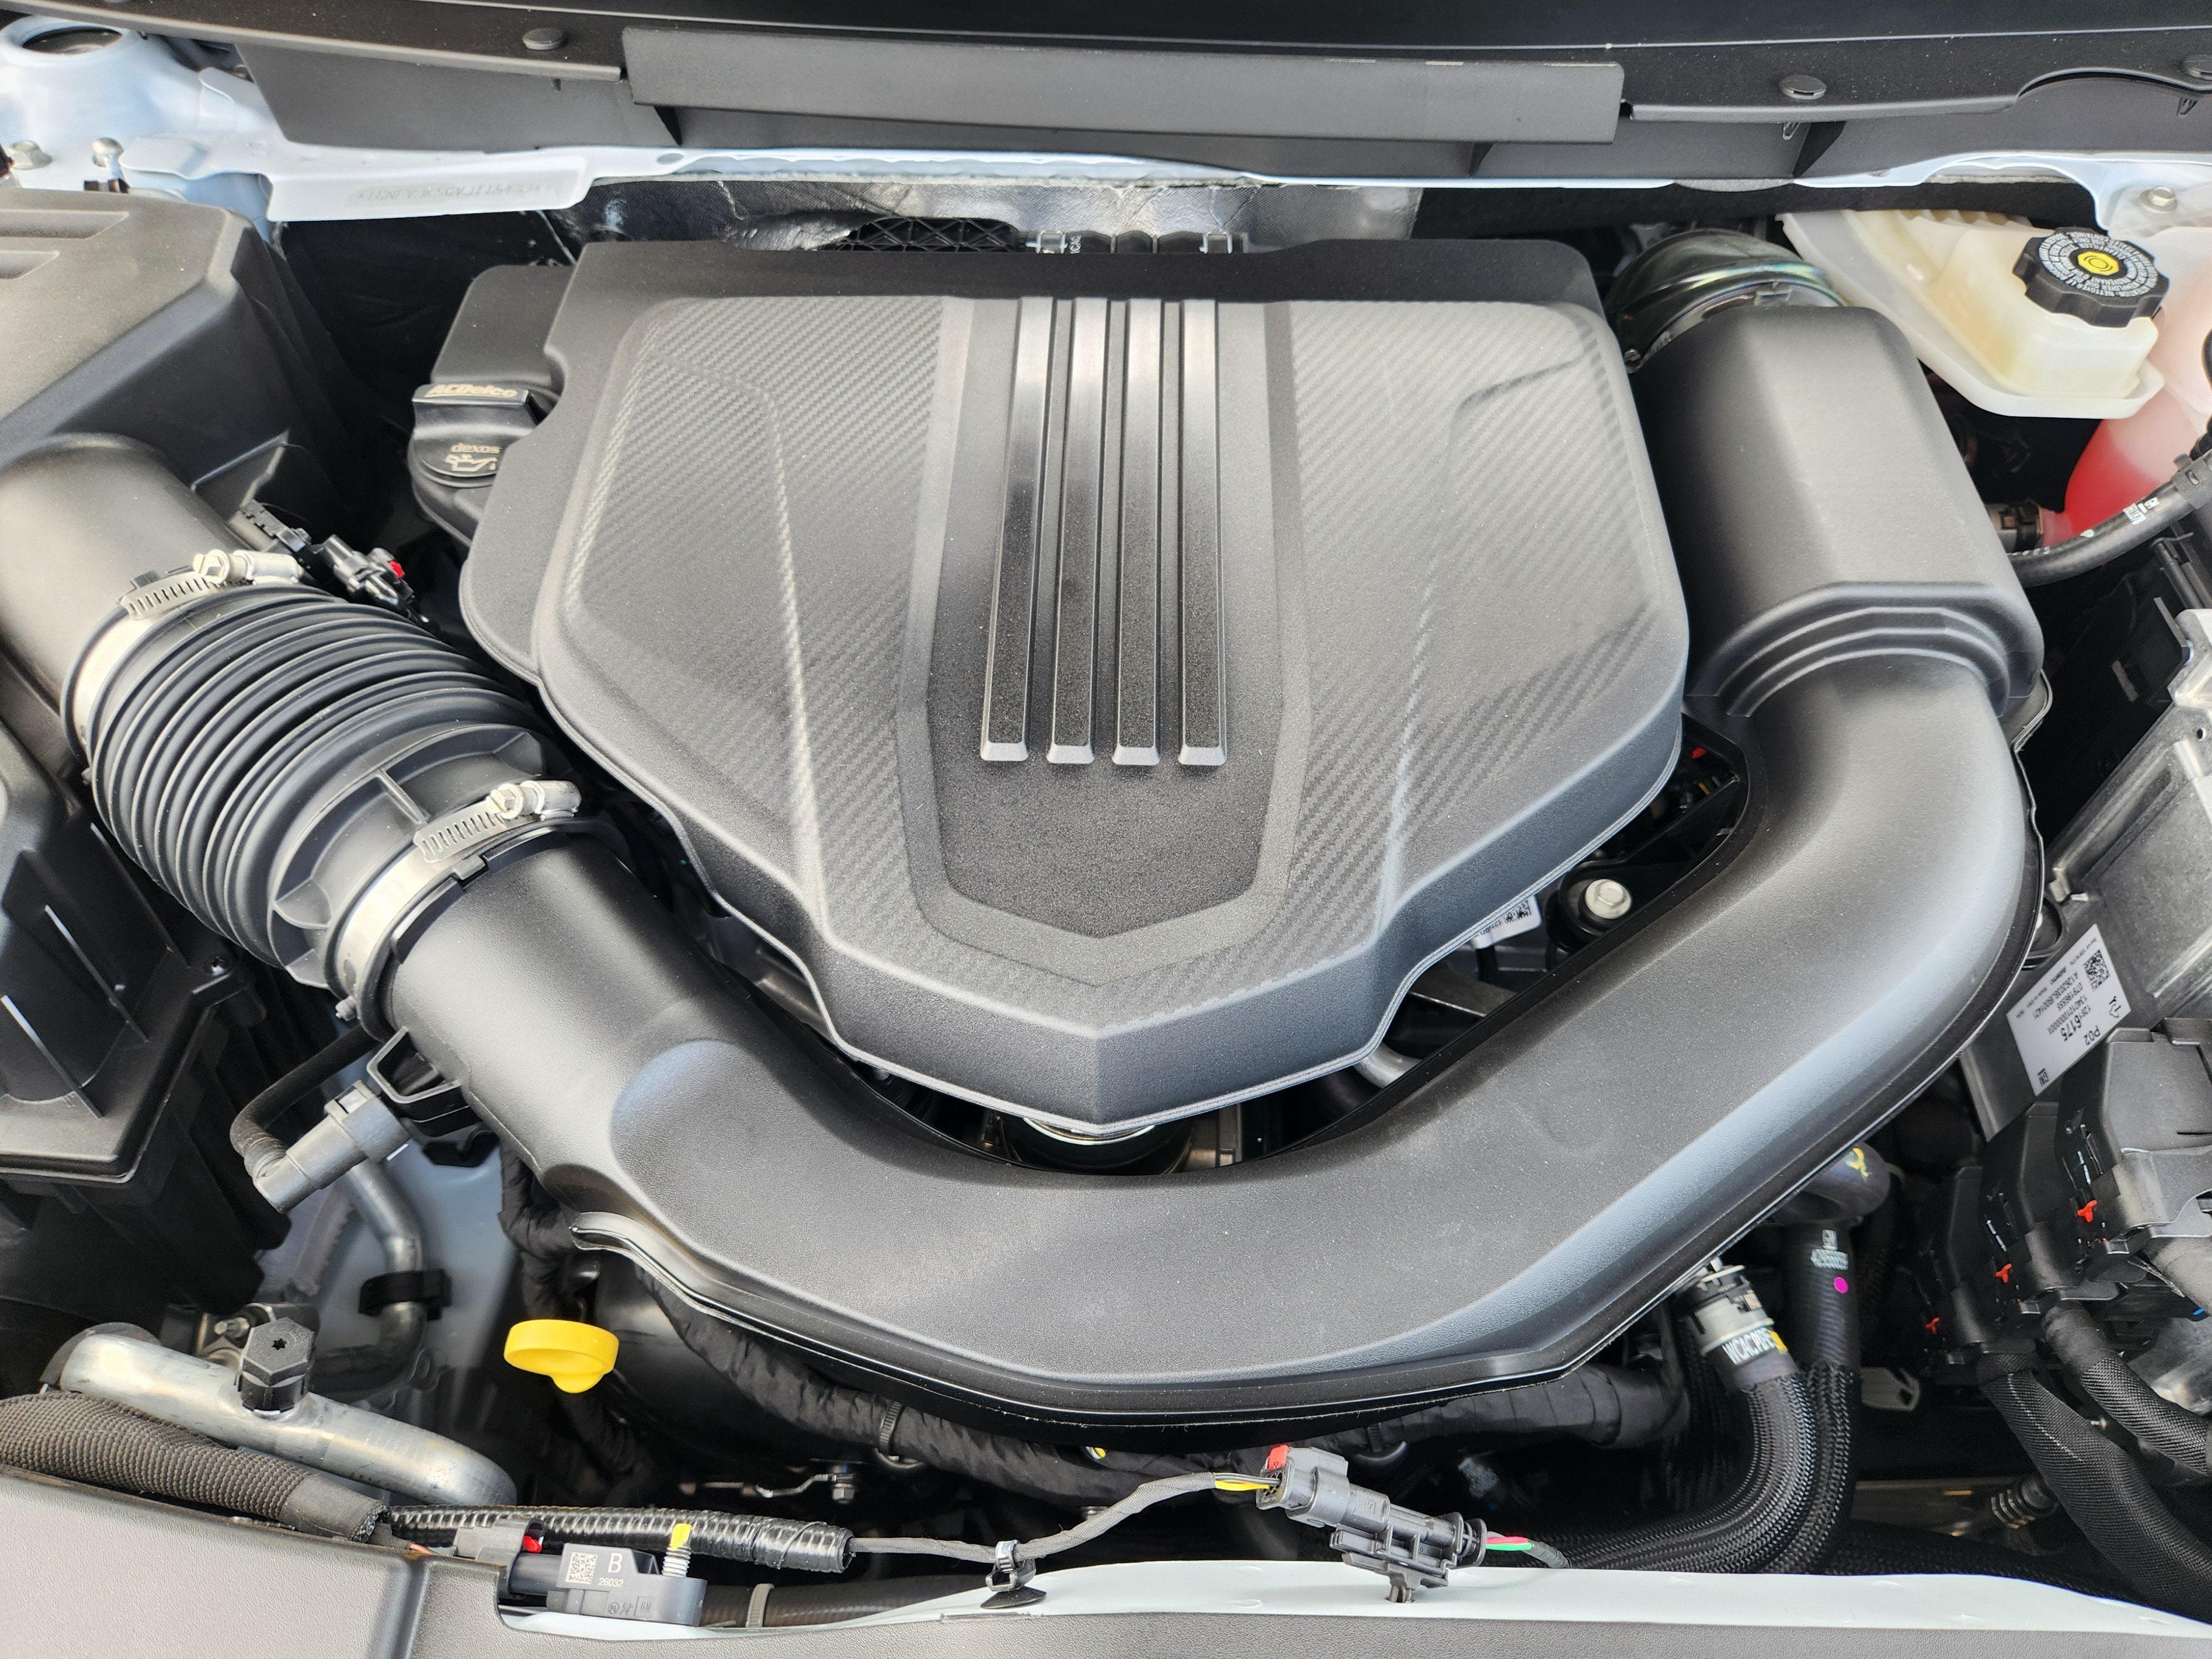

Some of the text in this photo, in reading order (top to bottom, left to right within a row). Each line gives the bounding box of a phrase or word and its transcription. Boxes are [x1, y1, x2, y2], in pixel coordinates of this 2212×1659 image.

[2083, 1024, 2100, 1047] P02
[608, 1552, 623, 1573] B
[598, 1577, 624, 1588] 26032
